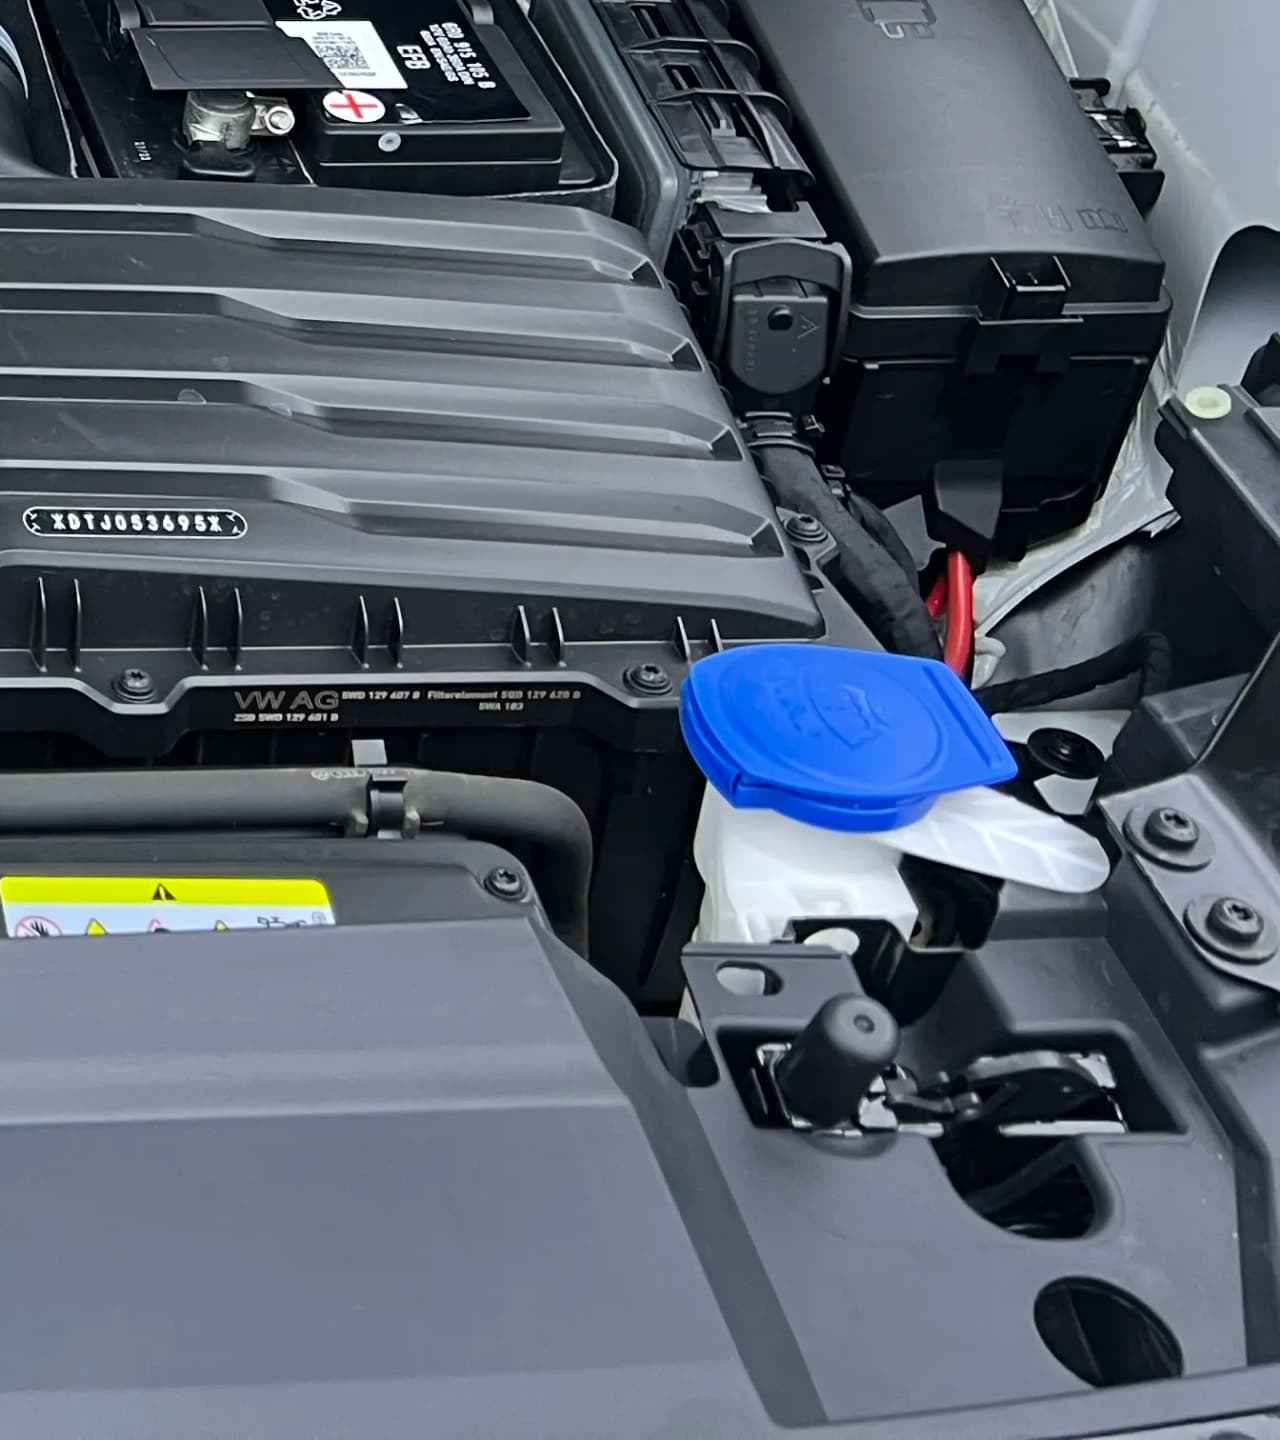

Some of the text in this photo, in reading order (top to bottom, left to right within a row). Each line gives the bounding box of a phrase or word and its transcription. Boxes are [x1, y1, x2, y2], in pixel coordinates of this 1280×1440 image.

[396, 45, 431, 69] EFB
[233, 690, 340, 710] VW AG
